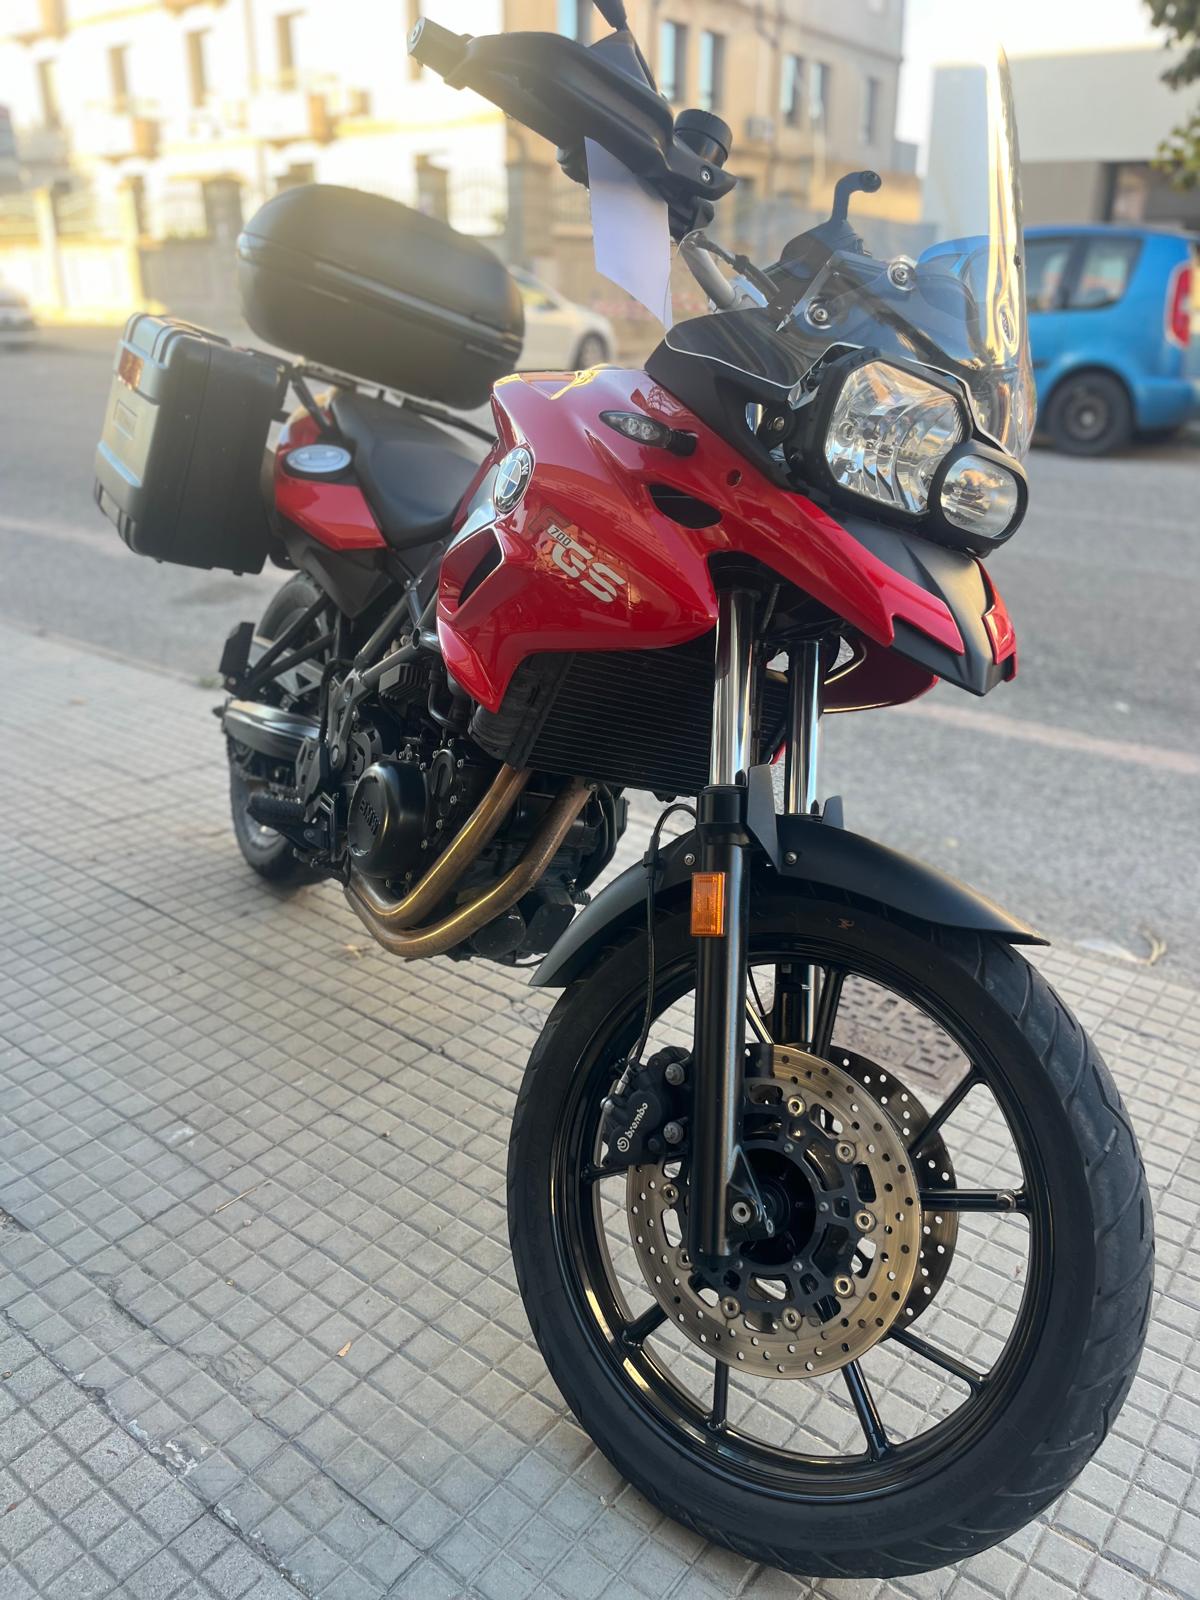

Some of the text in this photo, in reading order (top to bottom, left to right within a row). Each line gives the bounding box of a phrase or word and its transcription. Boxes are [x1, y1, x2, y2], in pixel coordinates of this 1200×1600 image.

[549, 527, 572, 547] 700
[550, 532, 627, 603] GS
[359, 798, 380, 836] BMW
[624, 1102, 648, 1139] brembo
